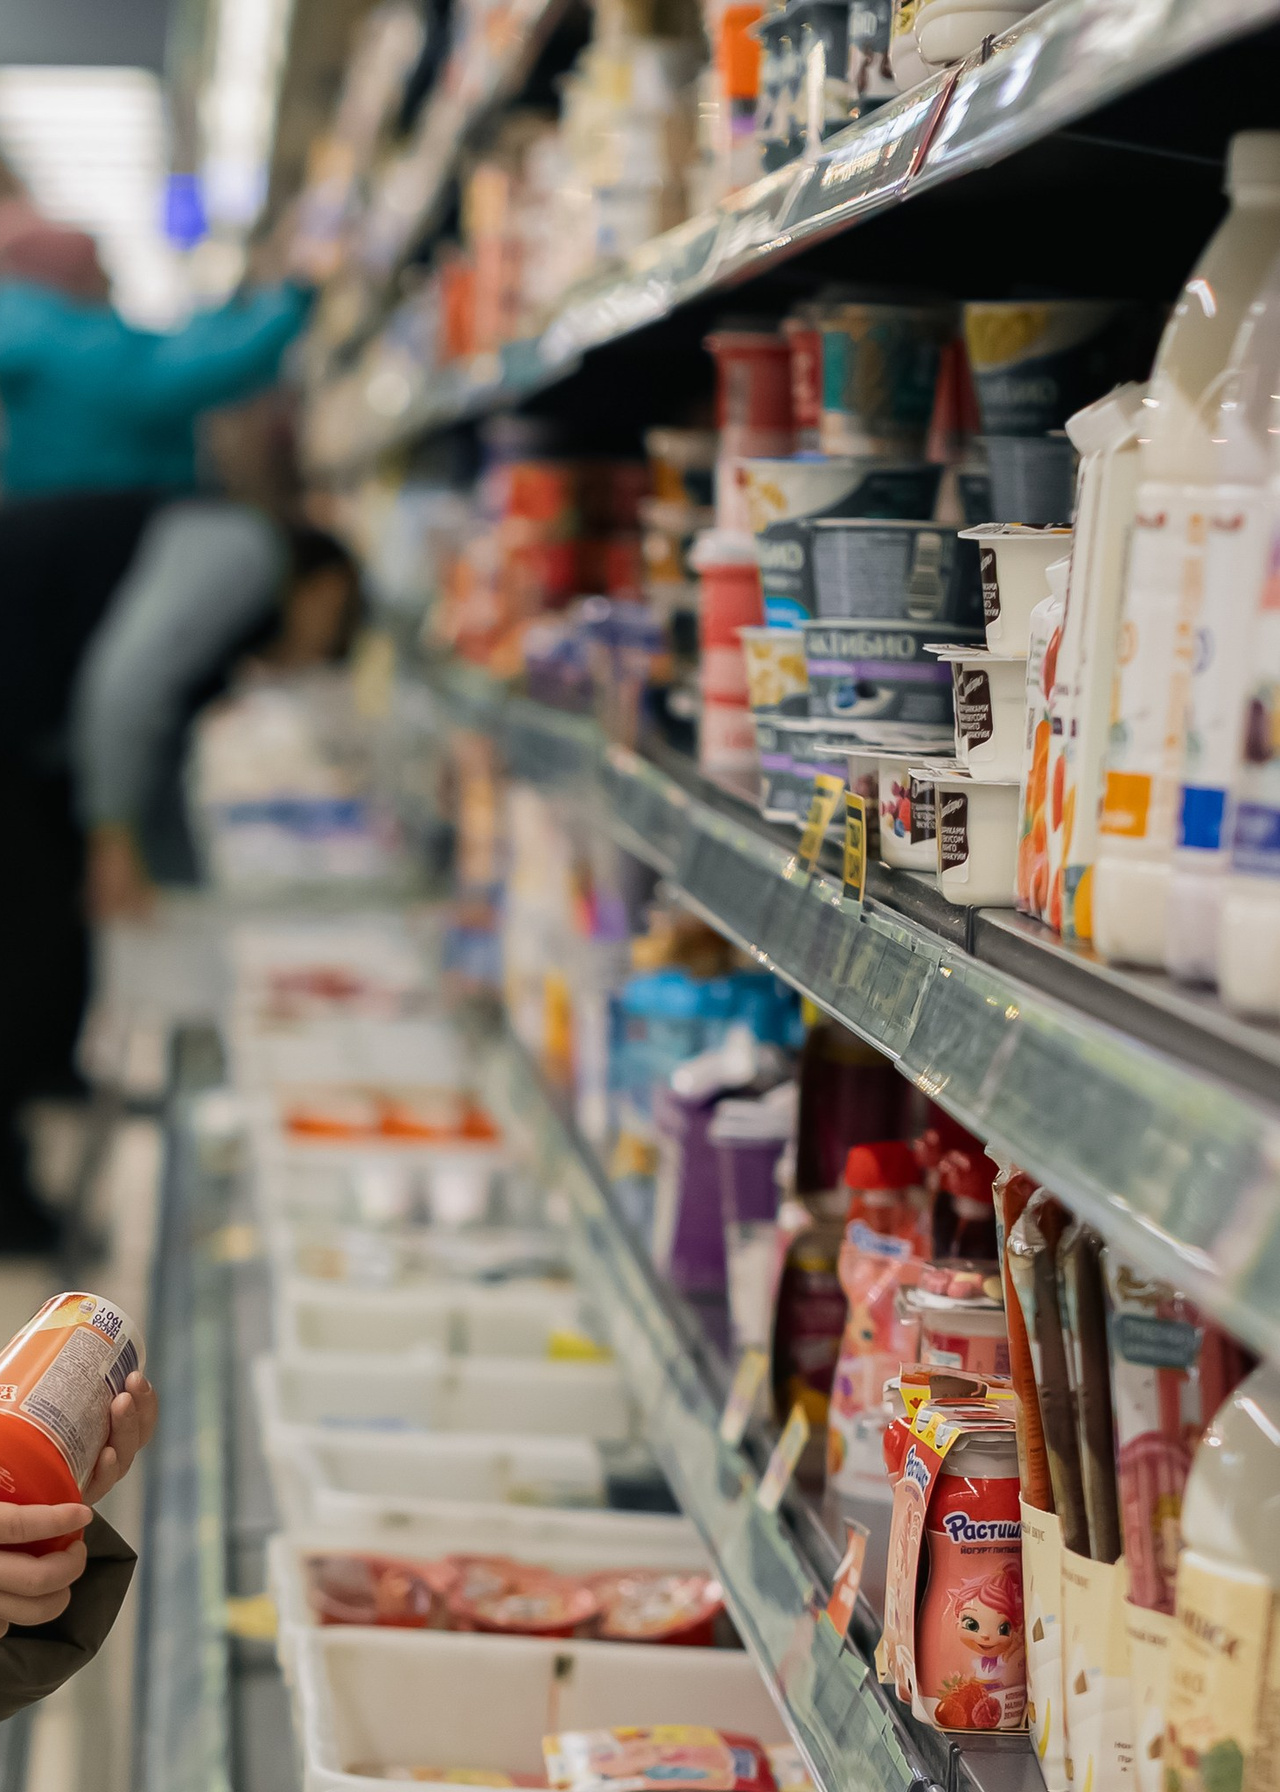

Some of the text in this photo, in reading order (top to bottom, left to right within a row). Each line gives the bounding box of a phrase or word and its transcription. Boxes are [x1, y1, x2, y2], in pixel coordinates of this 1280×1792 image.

[92, 1318, 118, 1340] МАССА
[94, 1313, 120, 1335] НЕТТО
[106, 1311, 123, 1329] 190
[960, 1545, 993, 1555] ЙОГУРТ
